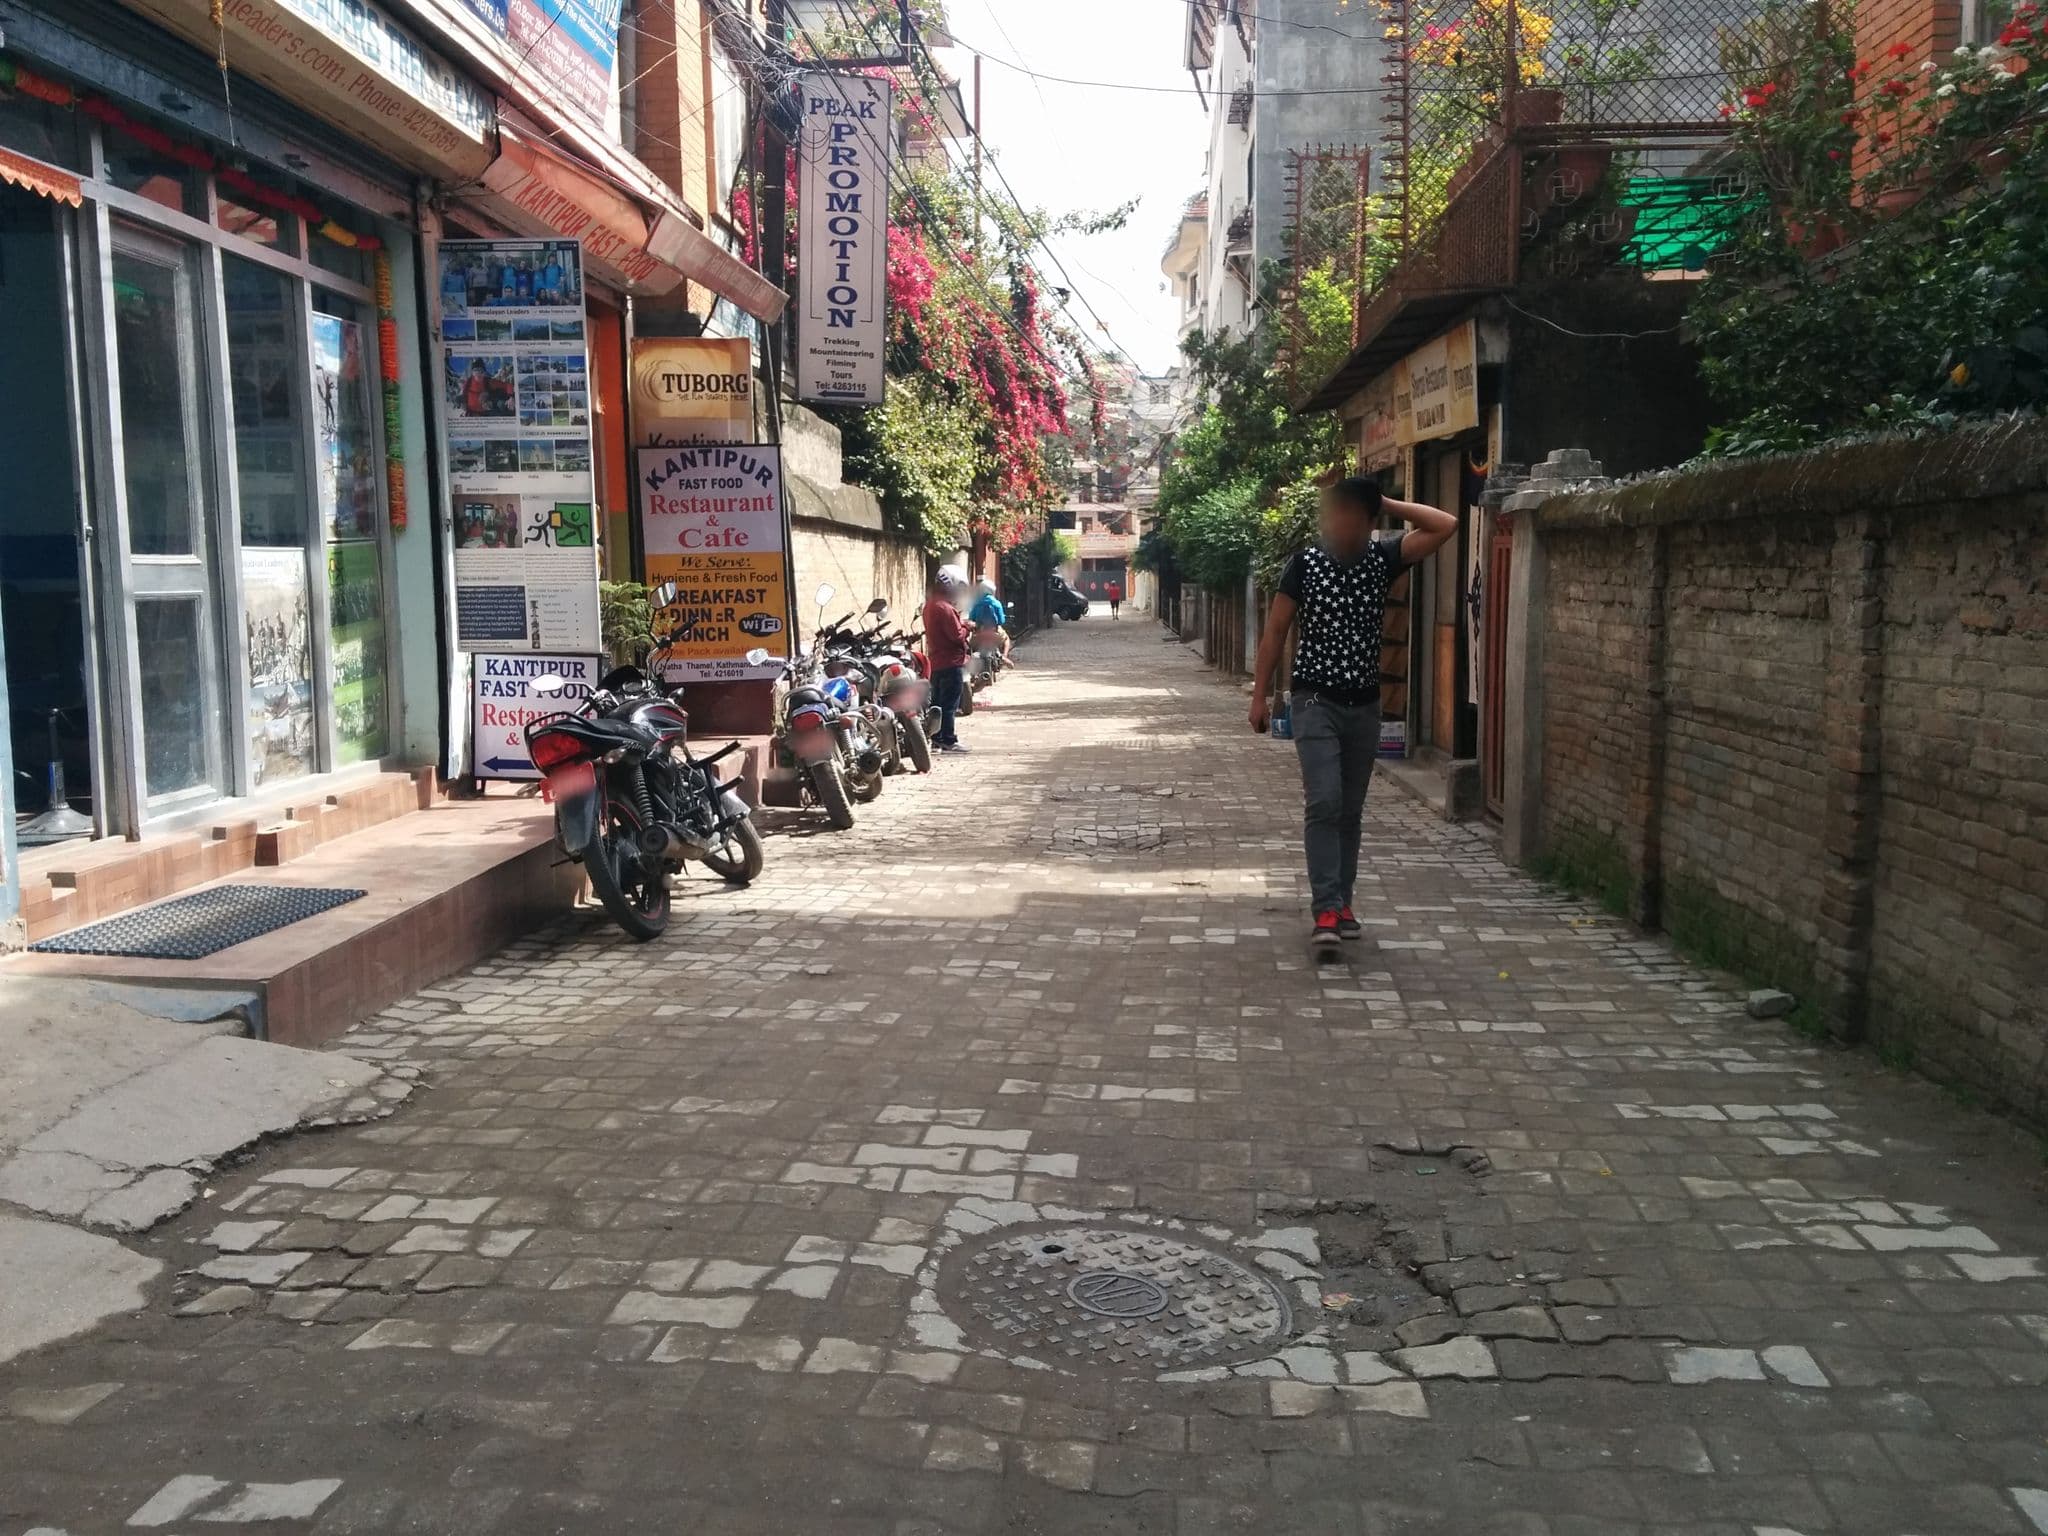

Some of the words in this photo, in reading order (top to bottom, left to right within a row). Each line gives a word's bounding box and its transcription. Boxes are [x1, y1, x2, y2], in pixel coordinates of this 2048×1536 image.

[809, 97, 876, 119] PEAK
[513, 178, 592, 238] KANTIPUR
[583, 224, 627, 260] FAST
[617, 247, 659, 280] FOOD
[825, 123, 862, 328] PROMOTION
[823, 337, 860, 347] Trekking
[809, 347, 874, 359] Mountaineering
[826, 360, 857, 368] Filming
[662, 373, 749, 393] TUBORG
[830, 370, 853, 379] Tours
[645, 450, 773, 492] KANTIPUR
[678, 478, 707, 490] FAST
[711, 477, 743, 488] FOOD
[650, 493, 775, 515] Restaurant
[706, 515, 720, 527] &
[678, 527, 749, 549] Cafe
[680, 557, 702, 568] We
[705, 556, 751, 568] Serve:
[703, 573, 711, 583] &
[714, 573, 747, 584] Fresh
[750, 572, 778, 583] Food
[671, 588, 768, 605] REAKFAST
[485, 659, 586, 678] KANTIPUR
[480, 680, 529, 698] FAST
[506, 732, 520, 745] &
